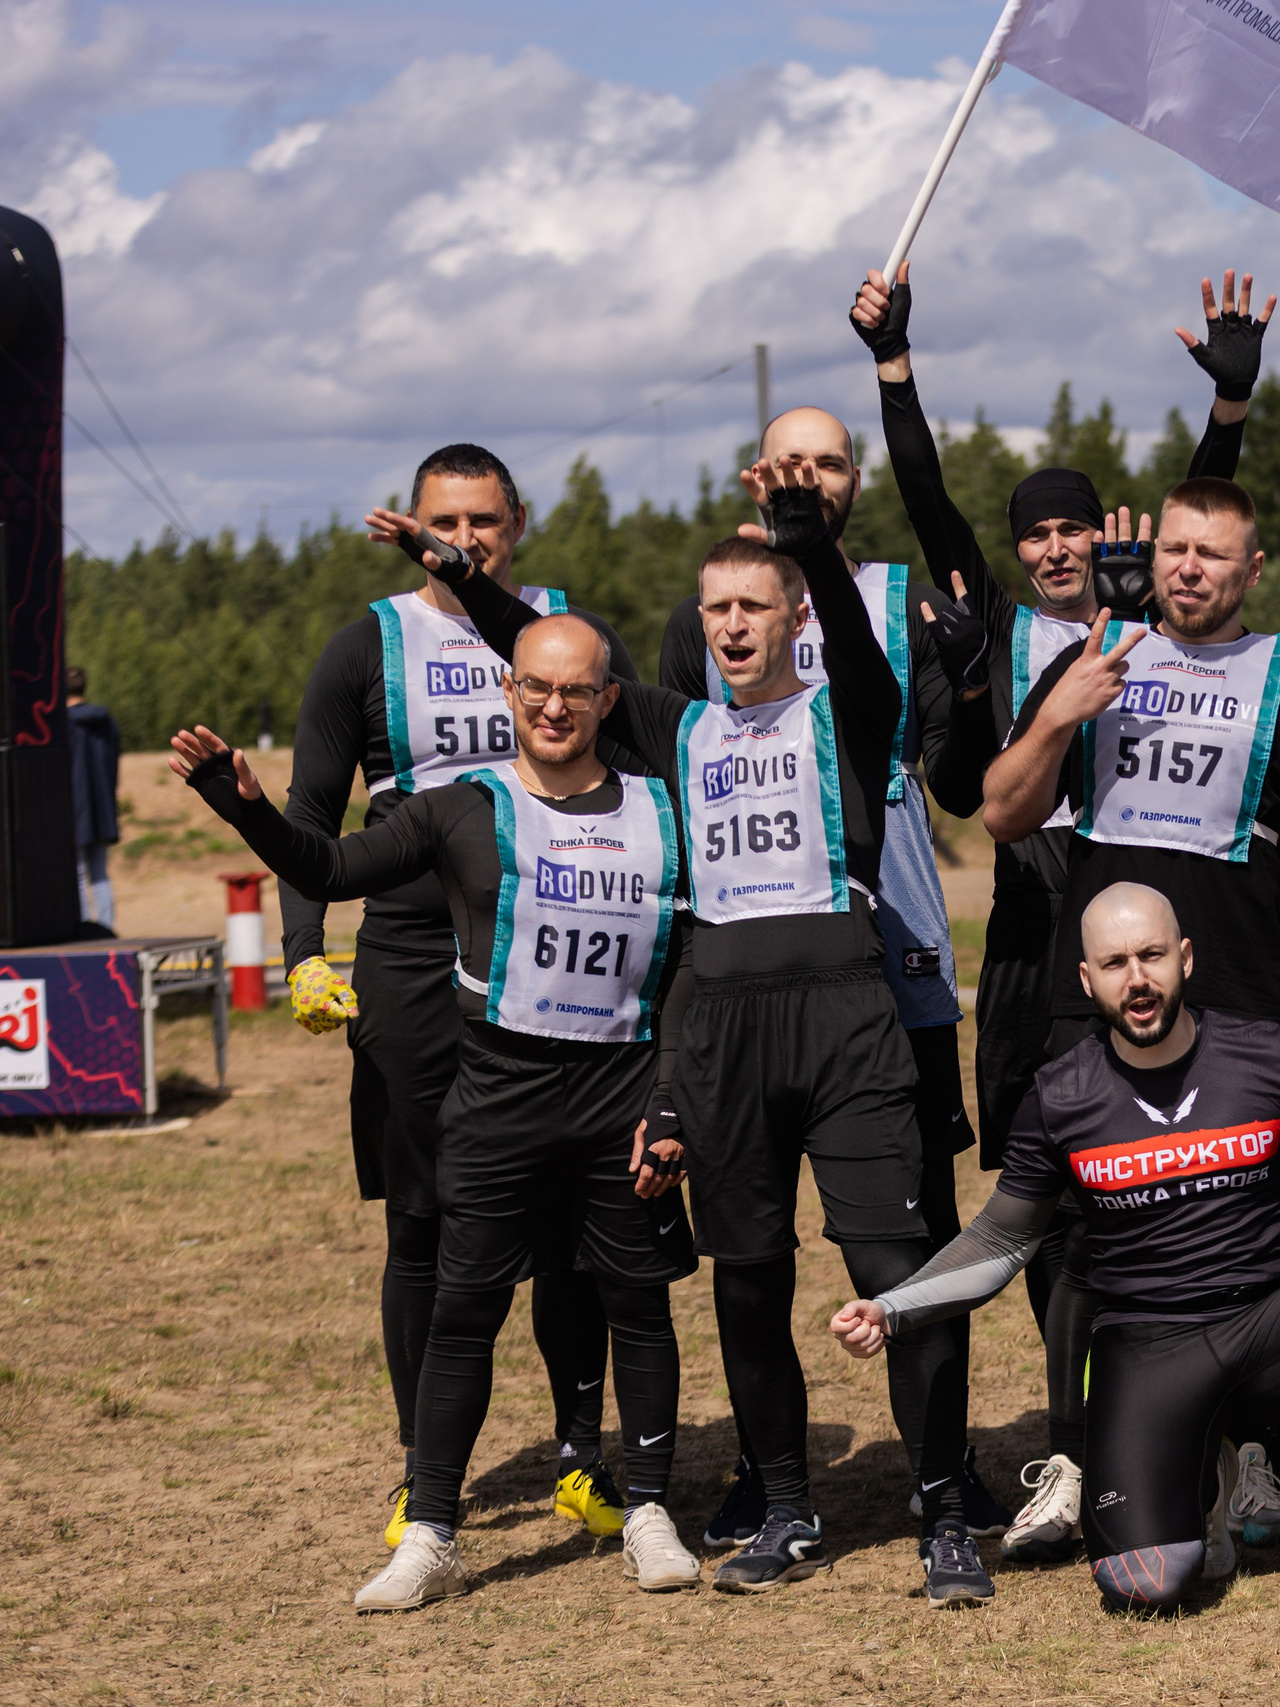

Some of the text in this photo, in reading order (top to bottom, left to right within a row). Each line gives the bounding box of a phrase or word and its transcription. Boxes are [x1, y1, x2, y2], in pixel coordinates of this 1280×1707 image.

[442, 638, 475, 648] ГОНКА
[430, 663, 512, 692] RODV
[1151, 660, 1226, 676] ГОНКА ГЕРОЕВ
[1125, 685, 1239, 720] RODVIG
[434, 714, 519, 757] 516
[706, 752, 797, 796] RODVIG
[1115, 736, 1224, 787] 5157
[705, 810, 801, 862] 5163
[1139, 811, 1202, 826] ГАЗПРОМБАНК
[550, 837, 625, 849] ГОНКА ГЕРОЕВ
[540, 862, 645, 905] RODVIG
[732, 882, 796, 896] ГАЗПРОМБАНК
[534, 924, 629, 977] 6121
[556, 1002, 615, 1018] ГАЗПРОМБАНК
[1078, 1129, 1274, 1184] ИНСТРУКТОР
[1093, 1165, 1270, 1210] ГОНКА ГЕРОЕВ
